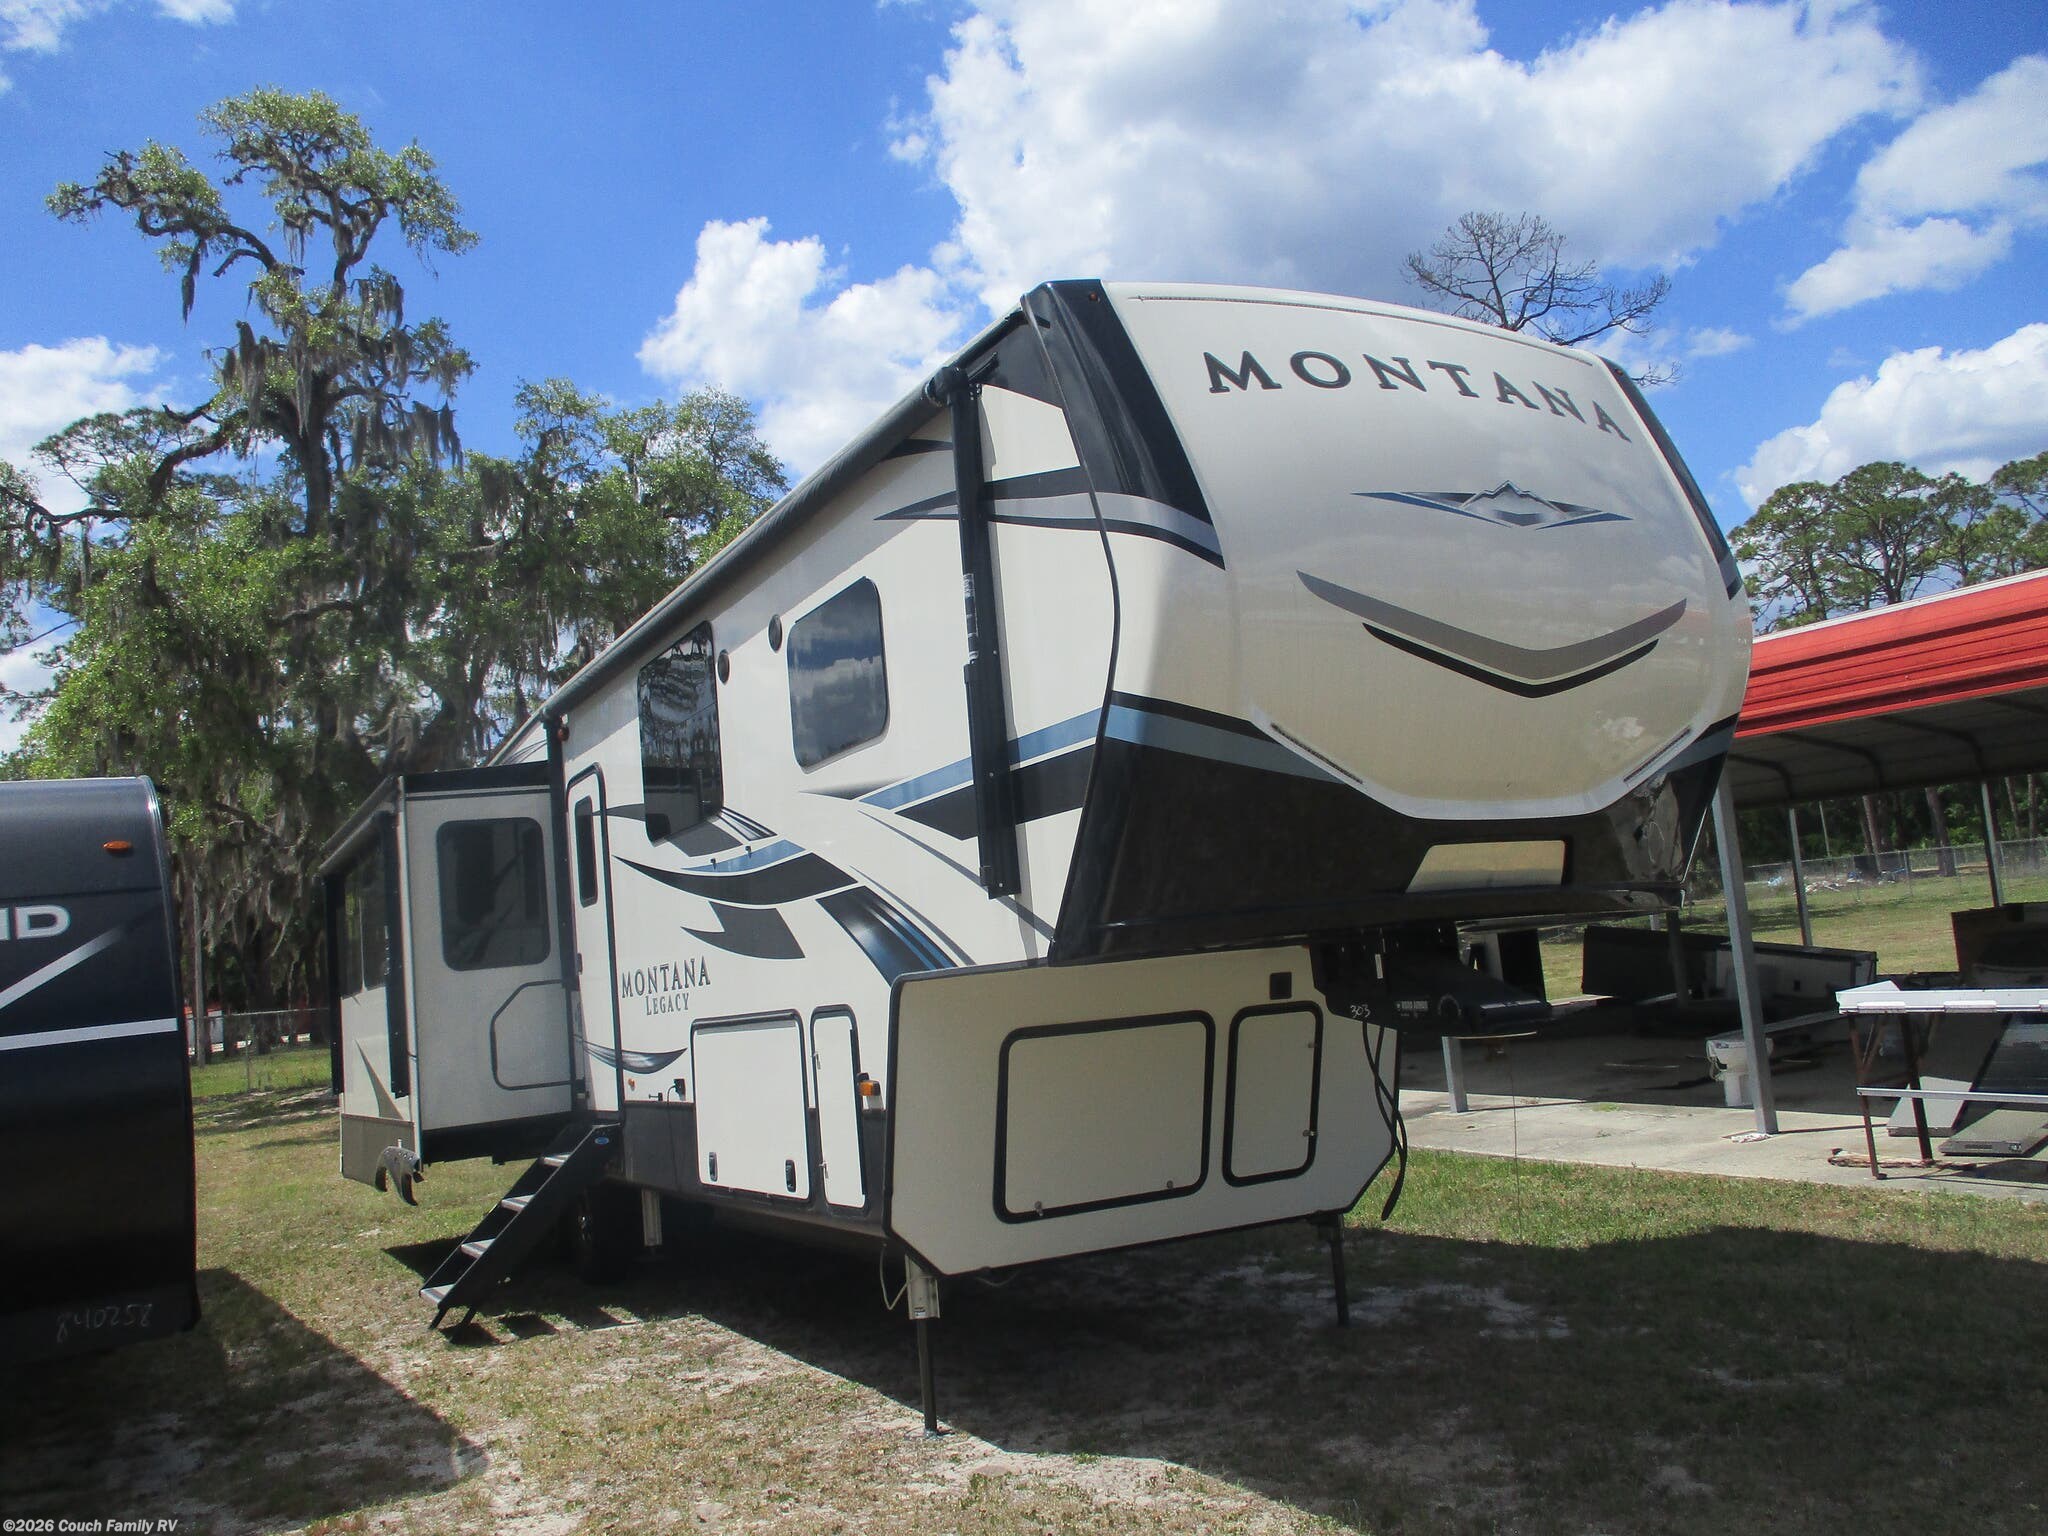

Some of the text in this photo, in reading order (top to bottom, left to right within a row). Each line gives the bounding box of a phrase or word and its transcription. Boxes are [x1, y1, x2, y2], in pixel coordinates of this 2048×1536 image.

[1203, 350, 1632, 442] MONTANA
[0, 904, 71, 940] D
[621, 955, 711, 998] MONTANA
[645, 992, 689, 1016] LEGACY
[1350, 1003, 1371, 1018] 303
